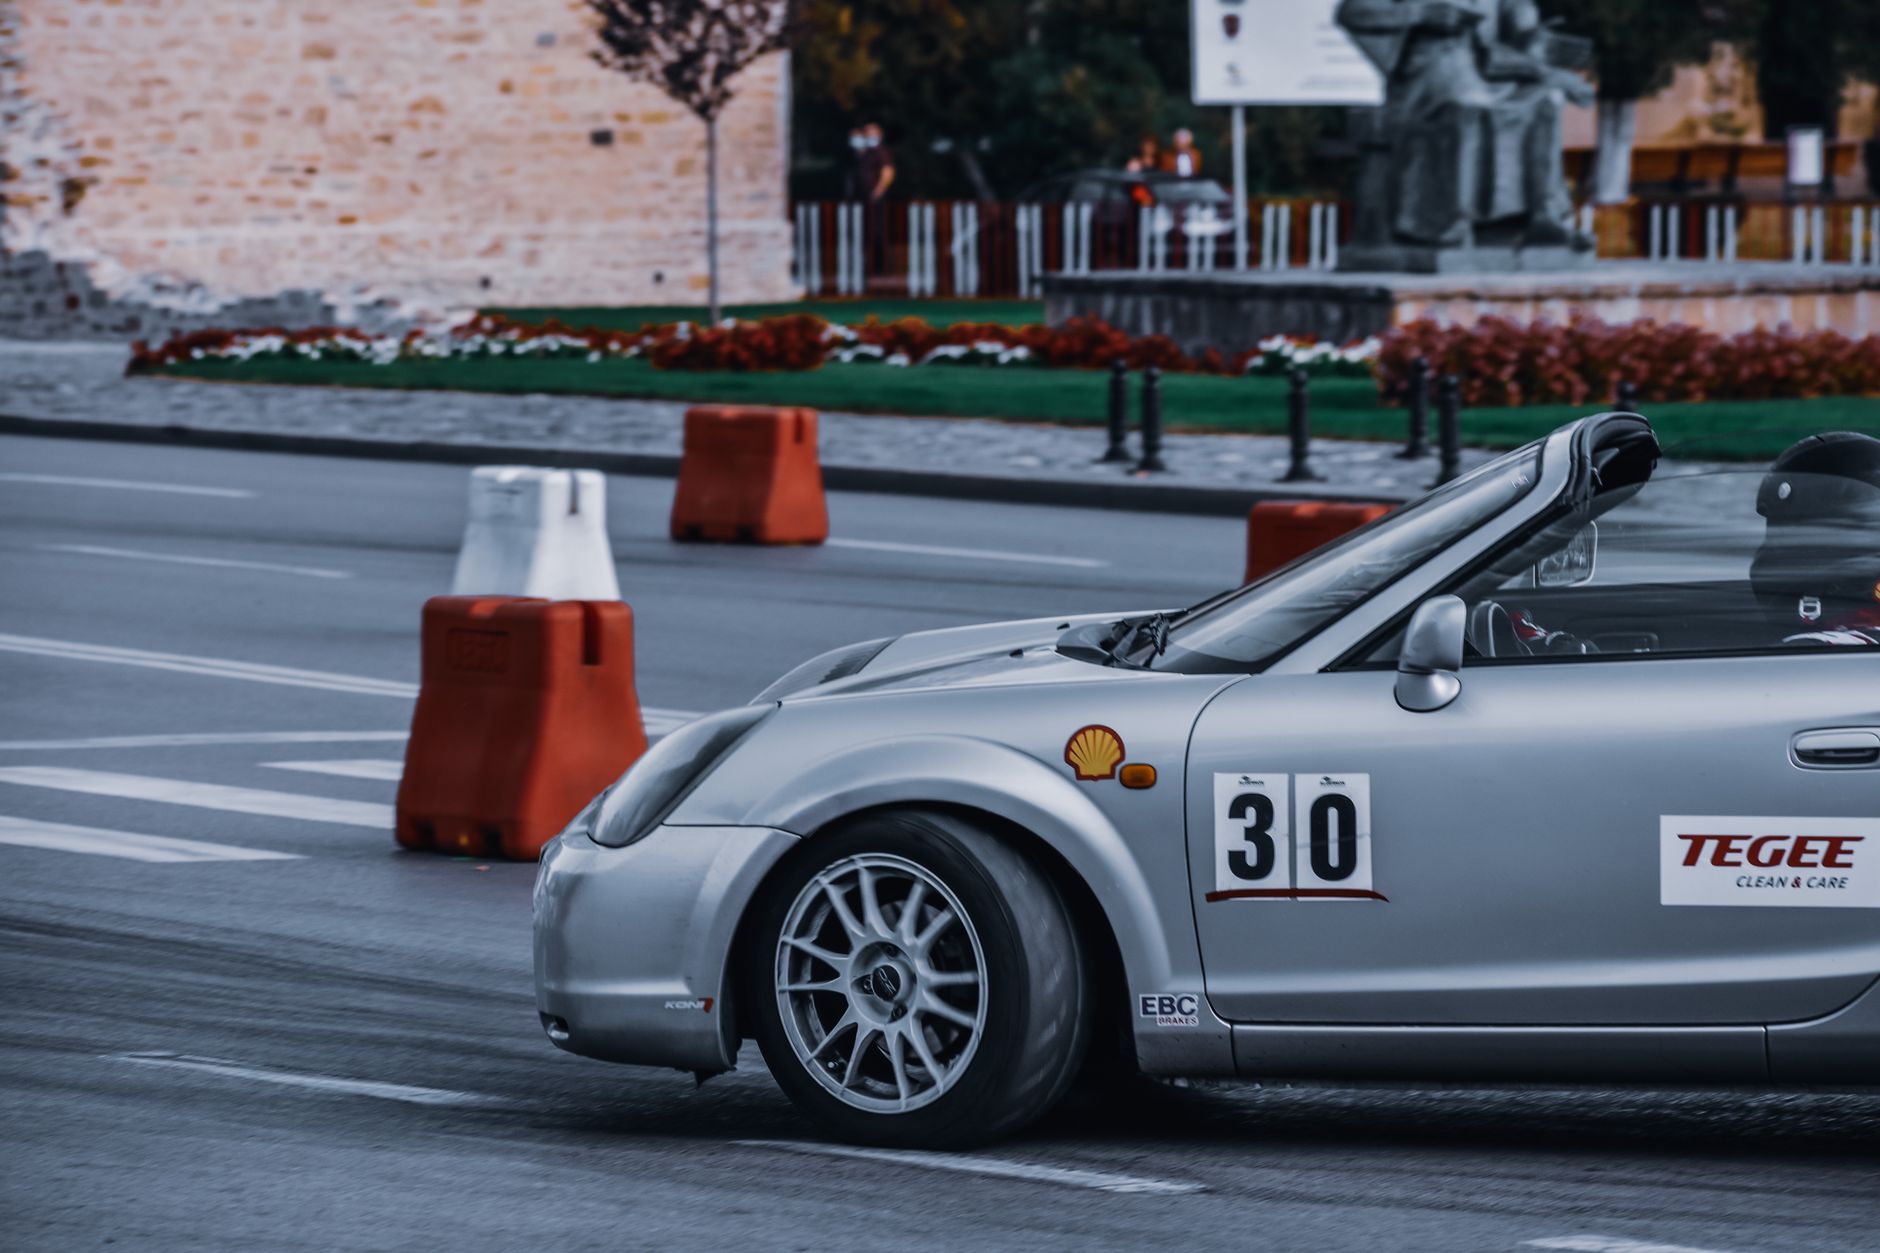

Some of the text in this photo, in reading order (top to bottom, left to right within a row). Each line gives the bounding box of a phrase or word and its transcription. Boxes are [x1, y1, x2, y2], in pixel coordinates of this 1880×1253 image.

[1228, 793, 1357, 881] 30
[1677, 834, 1865, 868] TEGEE
[1736, 876, 1848, 889] CLEAN & CARE
[664, 1000, 706, 1010] KONI
[1141, 996, 1196, 1016] EBC
[1159, 1016, 1197, 1025] BRAKES
